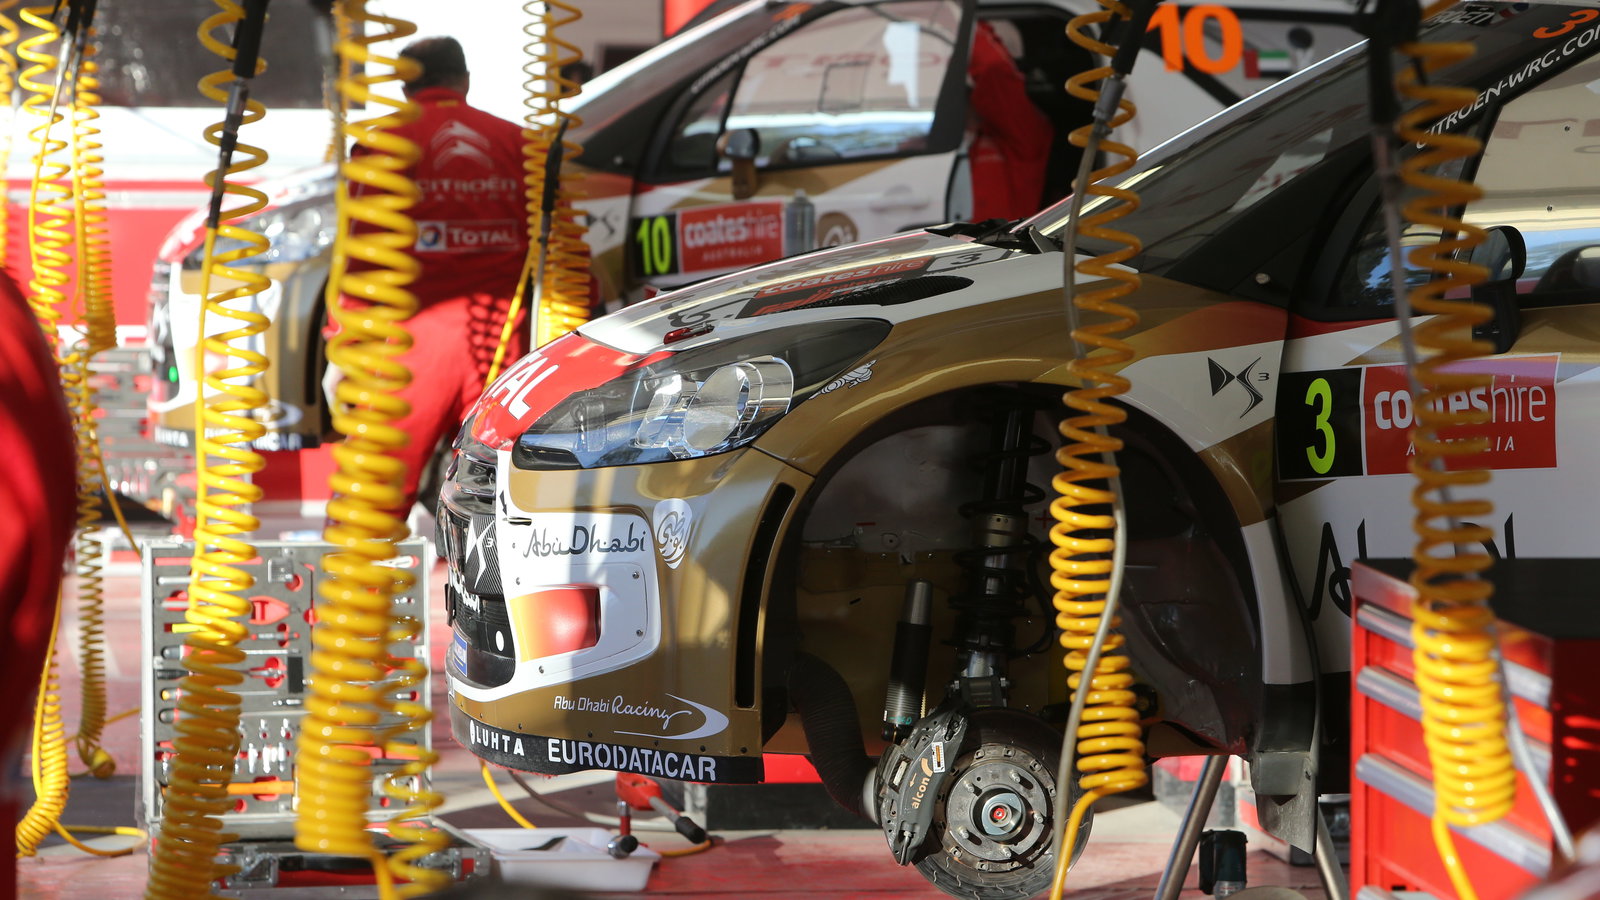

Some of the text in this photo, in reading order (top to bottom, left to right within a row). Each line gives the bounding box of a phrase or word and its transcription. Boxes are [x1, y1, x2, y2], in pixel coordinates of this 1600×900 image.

[1146, 3, 1243, 74] 10
[1533, 9, 1599, 38] 3
[449, 227, 514, 245] TOTAL
[636, 216, 671, 275] 10
[1305, 377, 1336, 475] 3
[553, 694, 692, 730] Abu Dhabi Racing
[475, 728, 525, 757] LUHTA
[548, 738, 717, 782] EURODATACAR
[911, 778, 929, 809] alcon
